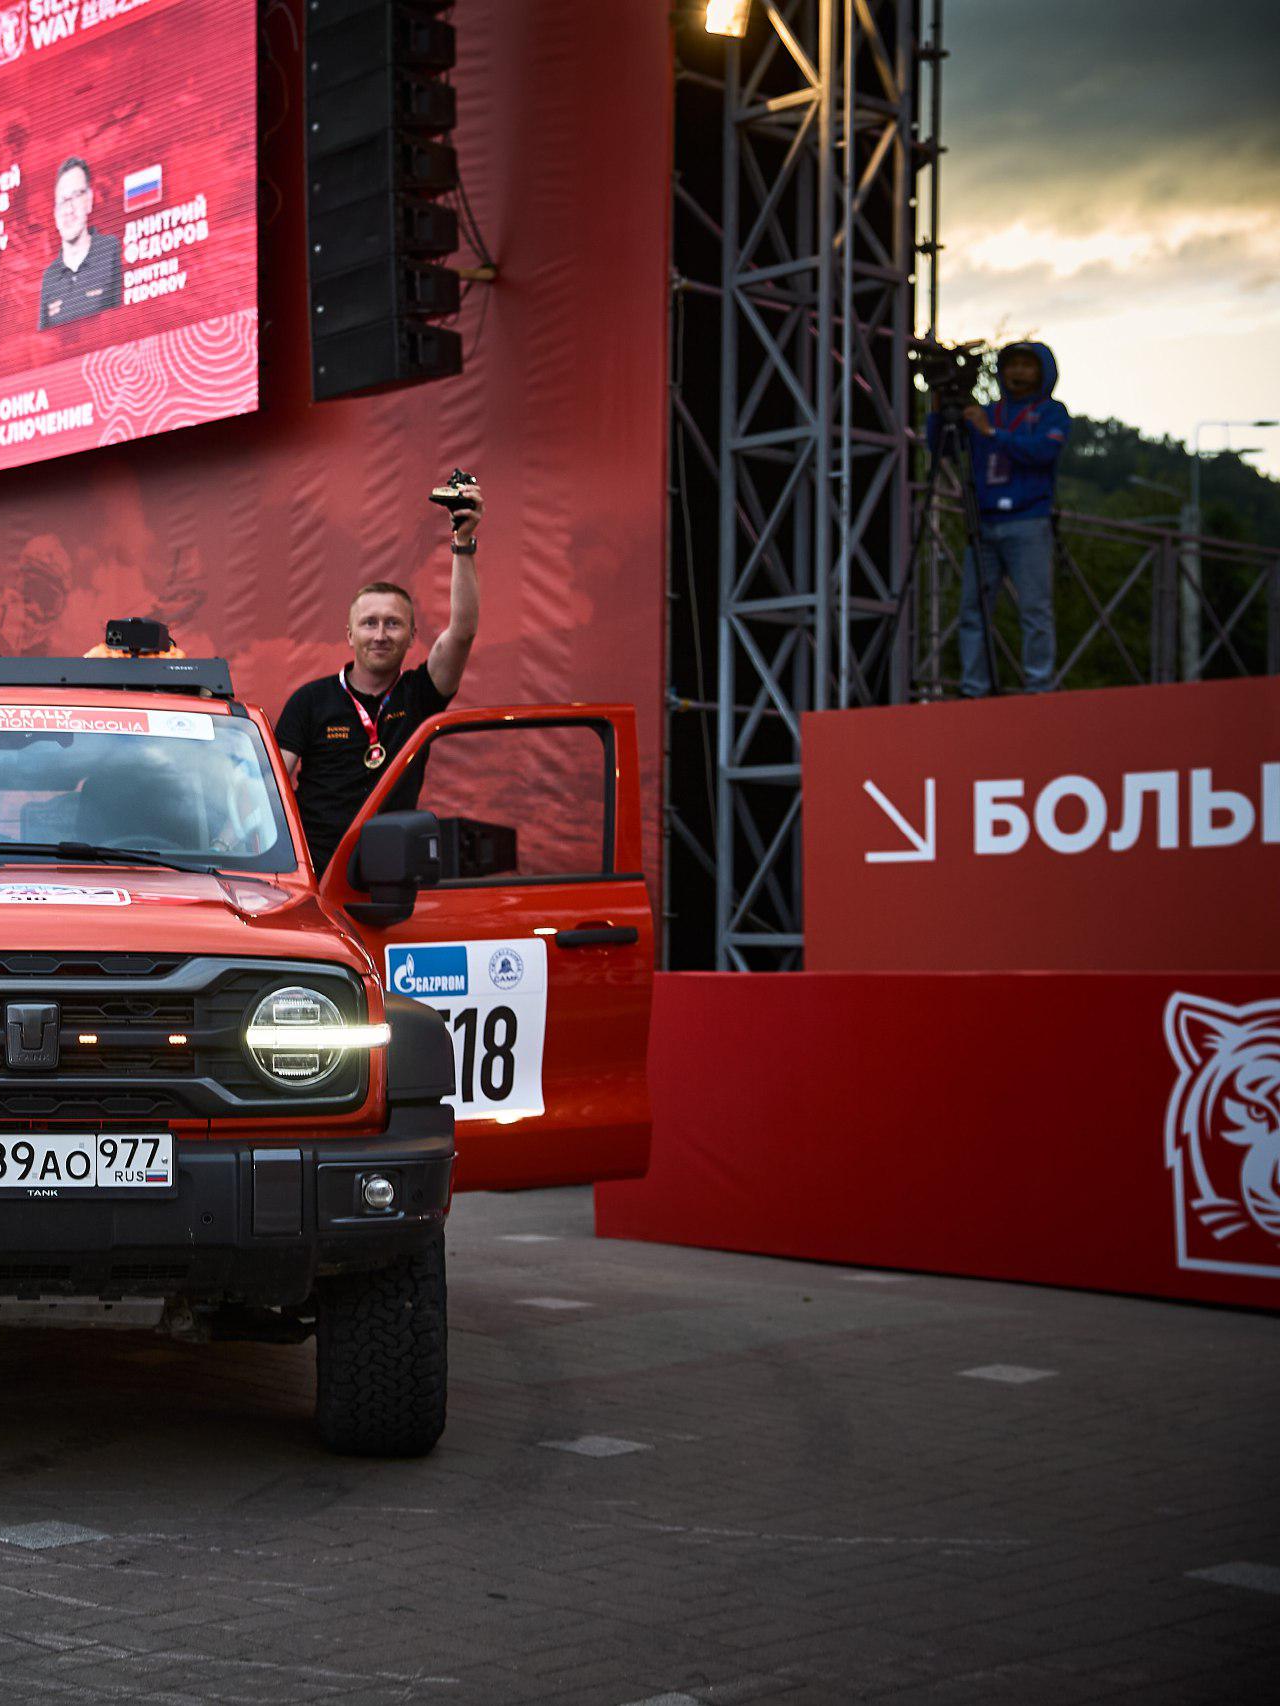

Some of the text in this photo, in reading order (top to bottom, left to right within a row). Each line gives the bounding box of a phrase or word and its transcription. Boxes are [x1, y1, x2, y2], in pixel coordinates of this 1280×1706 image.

[29, 6, 80, 50] WAY
[123, 193, 207, 244] ДМИТРИЙ
[124, 219, 208, 264] ФЕДОРОВ
[124, 272, 187, 305] FEDOROV
[20, 709, 72, 719] RALLY
[56, 718, 144, 732] MONGOLIA
[416, 975, 465, 993] GAZPROM
[437, 1006, 518, 1102] 18
[99, 1138, 160, 1169] 977
[115, 1171, 144, 1182] RUS
[27, 1189, 58, 1197] TANK
